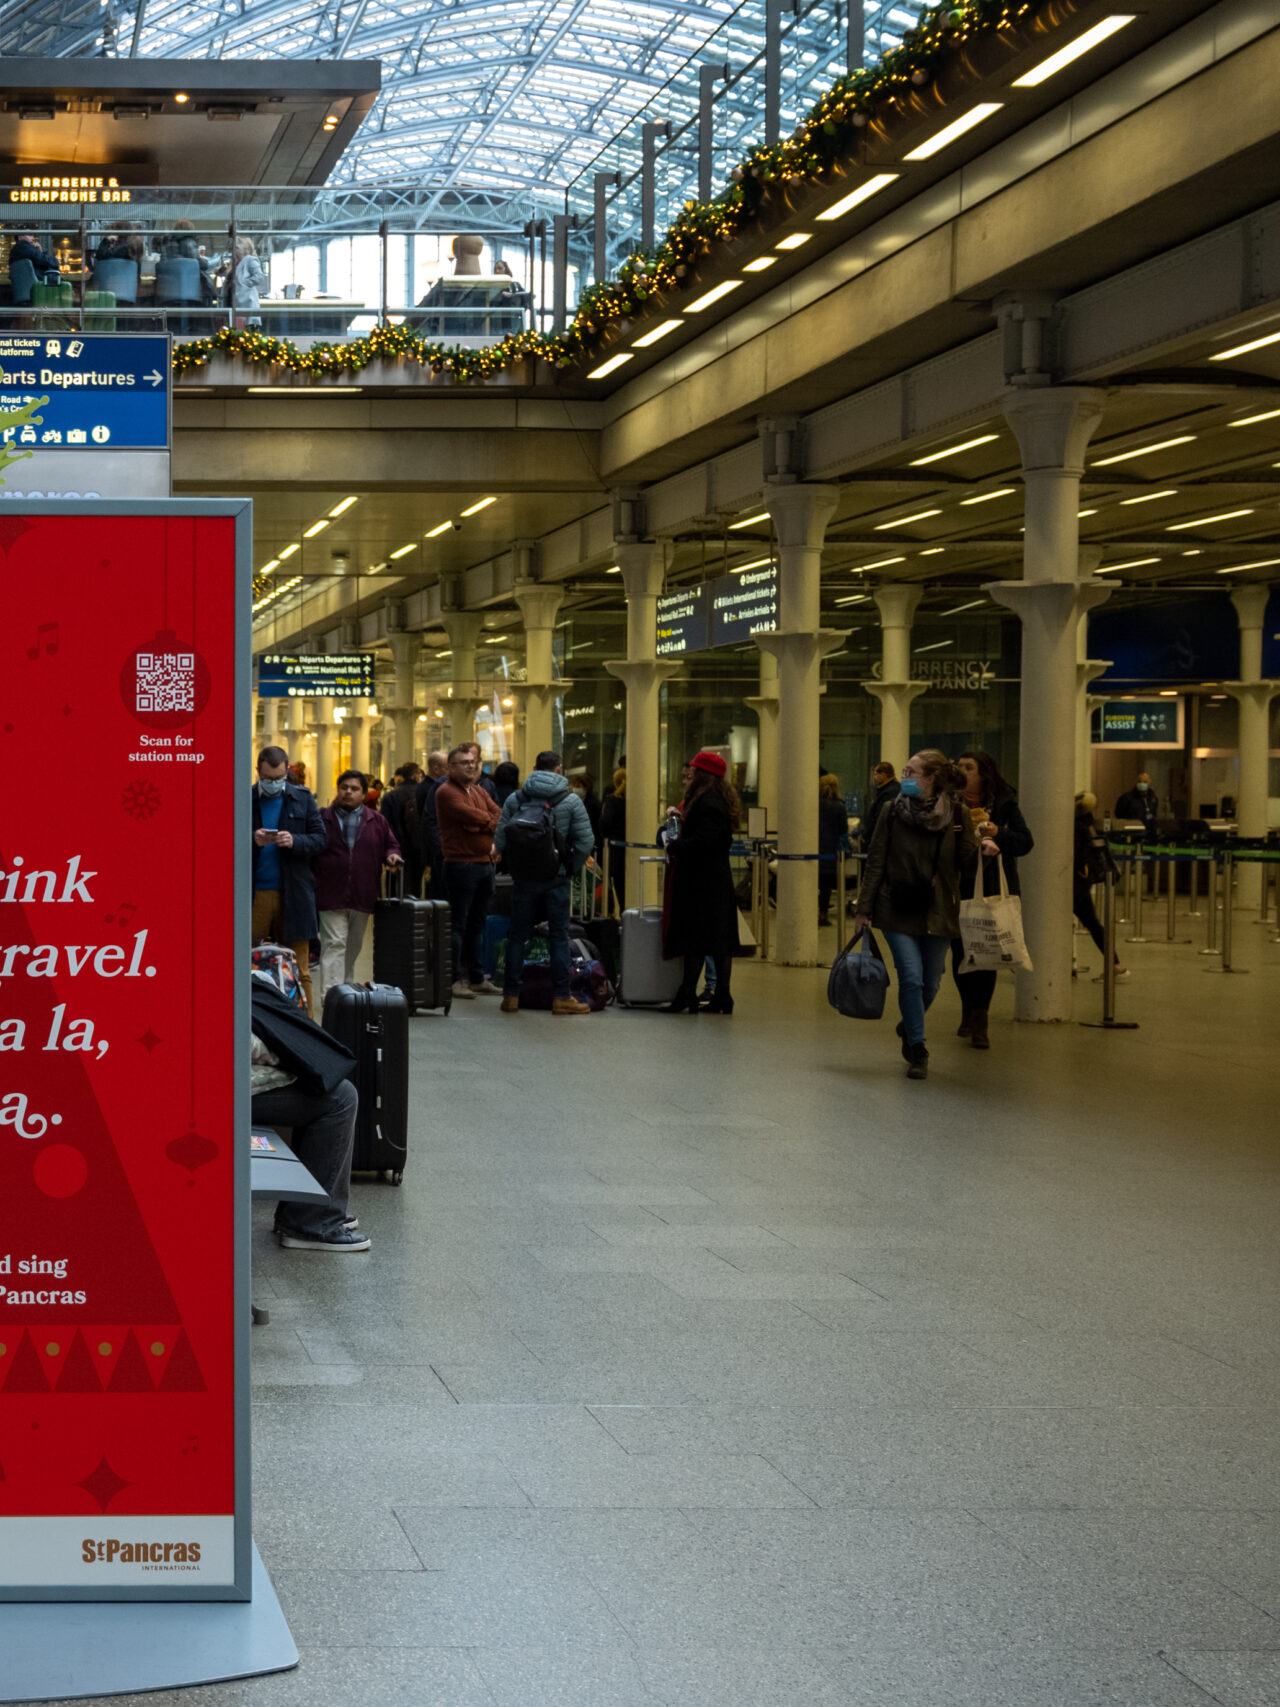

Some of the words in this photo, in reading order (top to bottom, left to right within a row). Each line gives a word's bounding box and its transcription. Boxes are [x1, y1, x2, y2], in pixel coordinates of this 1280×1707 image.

[22, 177, 104, 188] BRASSERIE
[108, 178, 120, 188] &
[10, 190, 97, 202] CHAMPAGNE
[101, 190, 131, 202] BAR
[13, 338, 41, 347] tickets
[2, 370, 36, 385] arts
[40, 369, 136, 389] Departures
[1, 395, 22, 404] Road
[324, 655, 361, 665] Departures
[320, 665, 347, 674] National
[348, 665, 361, 674] Rail
[910, 661, 991, 675] URRENCY
[1105, 721, 1136, 730] ASSIST
[139, 734, 172, 747] Scan
[174, 734, 194, 747] for
[128, 750, 173, 762] station
[175, 753, 205, 765] map
[41, 1002, 111, 1061] la,
[17, 1254, 69, 1279] sing
